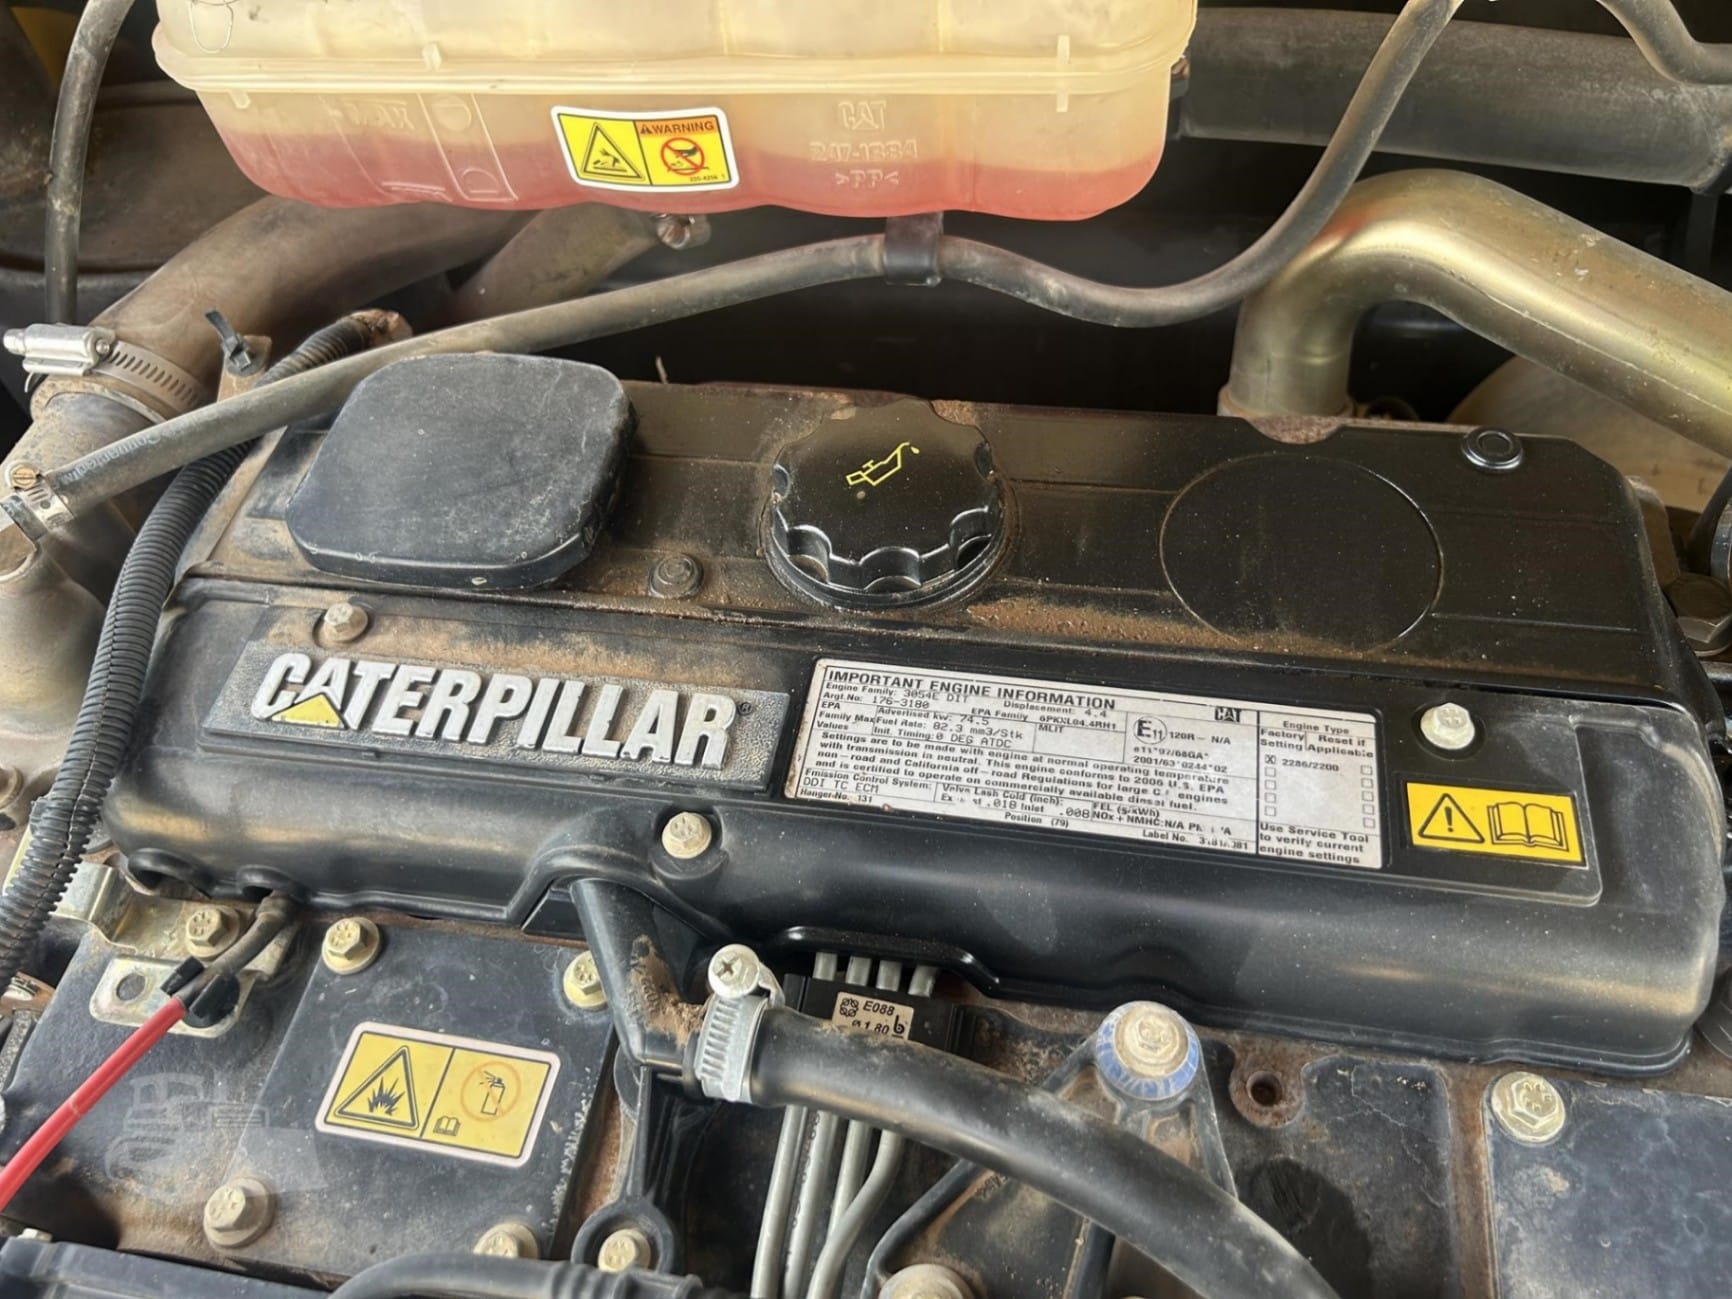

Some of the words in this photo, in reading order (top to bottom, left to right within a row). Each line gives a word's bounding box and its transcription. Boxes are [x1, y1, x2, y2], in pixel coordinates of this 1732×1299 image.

[838, 100, 887, 130] CAT
[652, 121, 714, 134] WARNING
[825, 681, 858, 692] Engine
[861, 685, 897, 697] Family:
[829, 670, 924, 689] IMPORTANT
[930, 680, 991, 697] ENGINE
[998, 687, 1116, 710] INFORMATION
[252, 653, 736, 769] CATERPILLAR
[821, 701, 841, 710] EPA
[819, 710, 852, 722] Family
[878, 707, 930, 719] Advertised
[960, 714, 990, 726] 74.5
[971, 707, 991, 716] EPA
[994, 710, 1029, 722] Family
[1084, 709, 1107, 718] 4.4
[1214, 706, 1242, 723] CAT
[816, 721, 849, 731] Values
[876, 716, 898, 726] Fuel
[933, 721, 963, 734] 82.3
[1283, 720, 1320, 733] Engine
[1323, 725, 1350, 735] Type
[950, 733, 974, 745] DEG
[981, 737, 1012, 748] ATDC
[1169, 731, 1195, 740] 120R
[1211, 735, 1231, 745] N/A
[1260, 739, 1303, 751] Setting
[1318, 734, 1354, 746] Reset
[821, 731, 867, 743] Settings
[870, 737, 888, 745] are
[892, 738, 903, 747] to
[906, 740, 920, 749] be
[924, 743, 956, 753] made
[960, 747, 984, 756] with
[988, 751, 1028, 761] engine
[1047, 757, 1088, 768] normal
[1092, 763, 1150, 777] operating
[820, 741, 843, 751] with
[846, 744, 918, 759] transmission
[922, 751, 933, 760] in
[986, 759, 1011, 769] This
[1014, 762, 1055, 774] engine
[1059, 767, 1115, 781] conforms
[1119, 773, 1130, 783] to
[1199, 784, 1225, 794] EPA
[803, 776, 826, 788] DDI
[834, 780, 849, 791] TC
[855, 782, 879, 794] ECM
[817, 750, 838, 759] non
[850, 754, 876, 763] road
[879, 757, 900, 766] and
[904, 759, 960, 773] California
[963, 766, 979, 775] off
[991, 769, 1018, 780] road
[1021, 773, 1093, 789] Regulations
[1096, 781, 1113, 791] for
[1117, 784, 1149, 796] large
[1177, 792, 1228, 805] engines
[852, 773, 889, 784] Control
[800, 788, 832, 799] Hanger
[815, 760, 836, 769] and
[853, 764, 901, 776] certified
[904, 769, 915, 777] to
[918, 771, 963, 783] operate
[966, 775, 982, 785] on
[985, 778, 1065, 796] commercially
[1068, 788, 1124, 802] available
[1169, 799, 1198, 812] fuel.
[974, 788, 999, 798] Lash
[1002, 791, 1026, 801] Cold
[1020, 803, 1044, 813] Inlet
[1004, 812, 1042, 825] Position
[1142, 829, 1170, 840] Label
[1260, 822, 1284, 833] Use
[1288, 825, 1337, 839] Service
[1341, 832, 1369, 843] Tool
[1260, 833, 1272, 842] to
[1276, 836, 1313, 849] verify
[1317, 841, 1363, 853] current
[1260, 845, 1304, 857] engine
[1308, 850, 1360, 864] settings
[863, 1001, 895, 1016] E088
